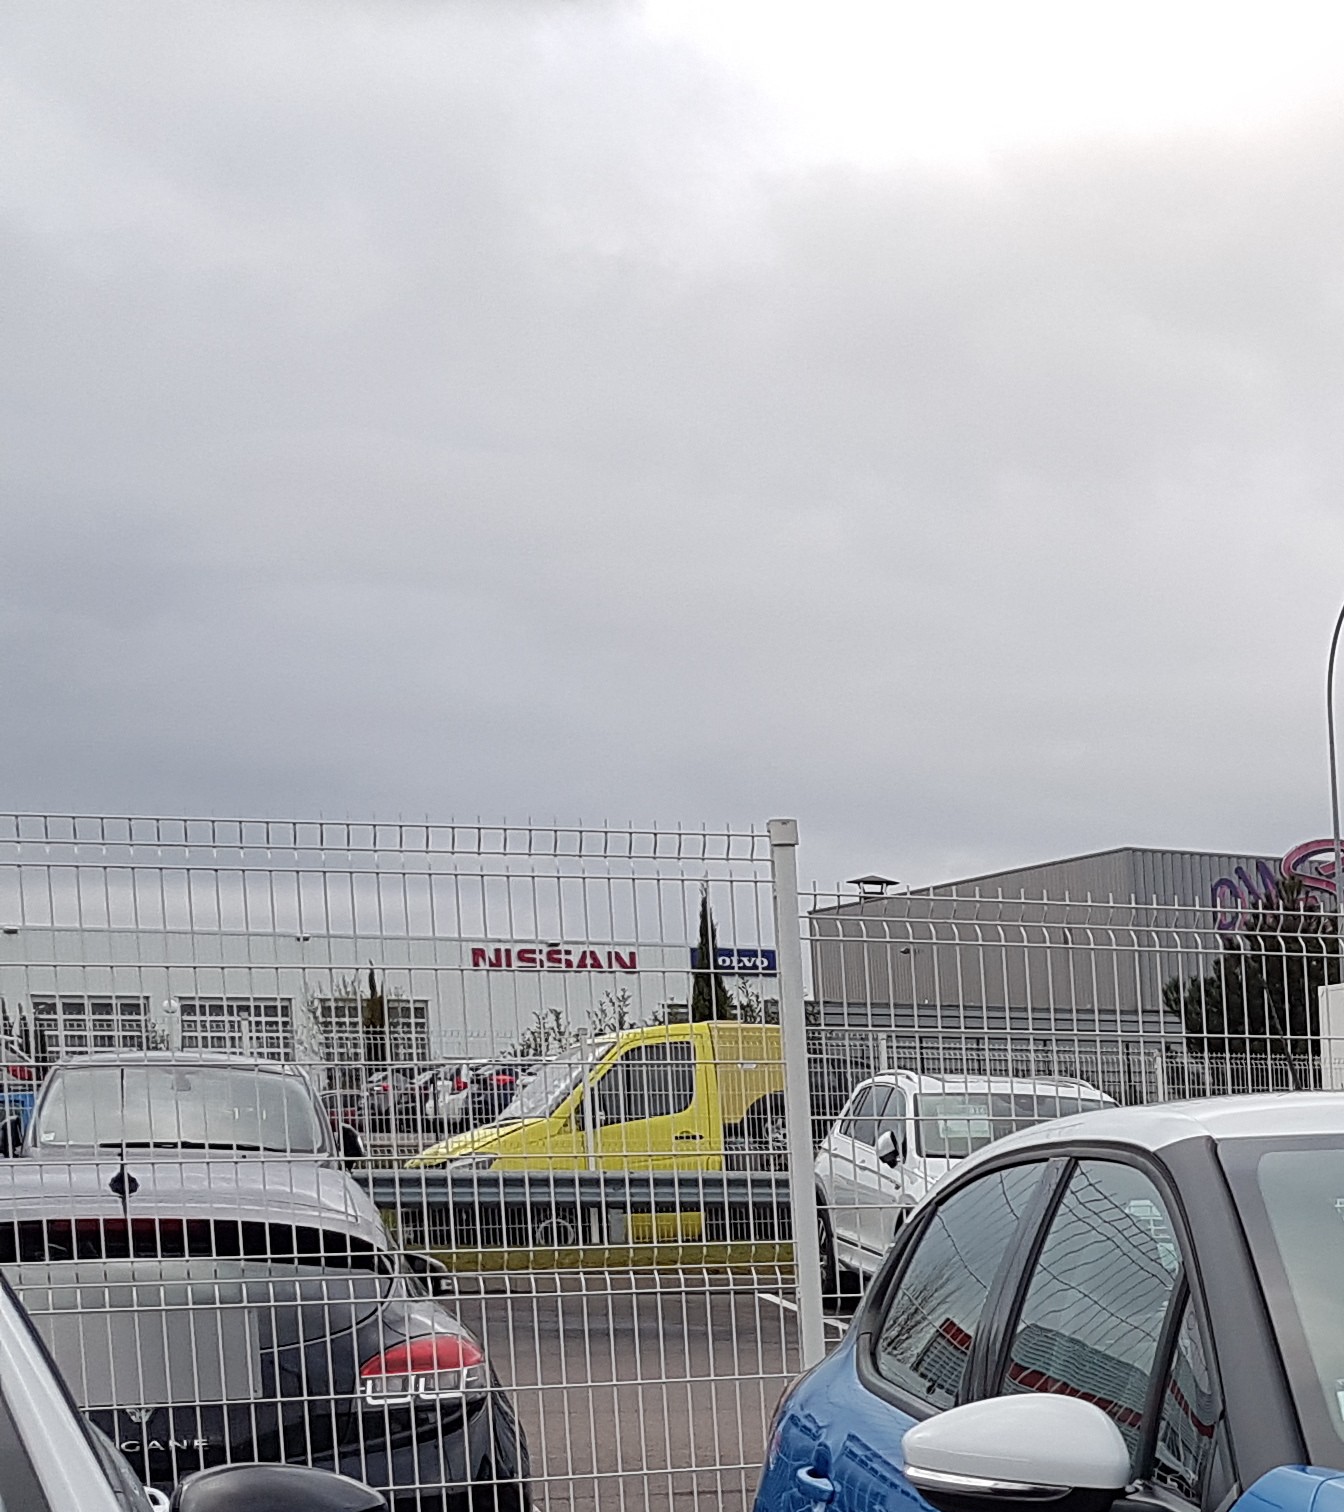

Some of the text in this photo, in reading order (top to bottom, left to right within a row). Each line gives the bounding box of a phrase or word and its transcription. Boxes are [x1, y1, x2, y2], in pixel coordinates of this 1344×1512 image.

[471, 947, 637, 972] NISSAN
[717, 956, 769, 968] OLVO
[120, 1439, 210, 1452] GANE
